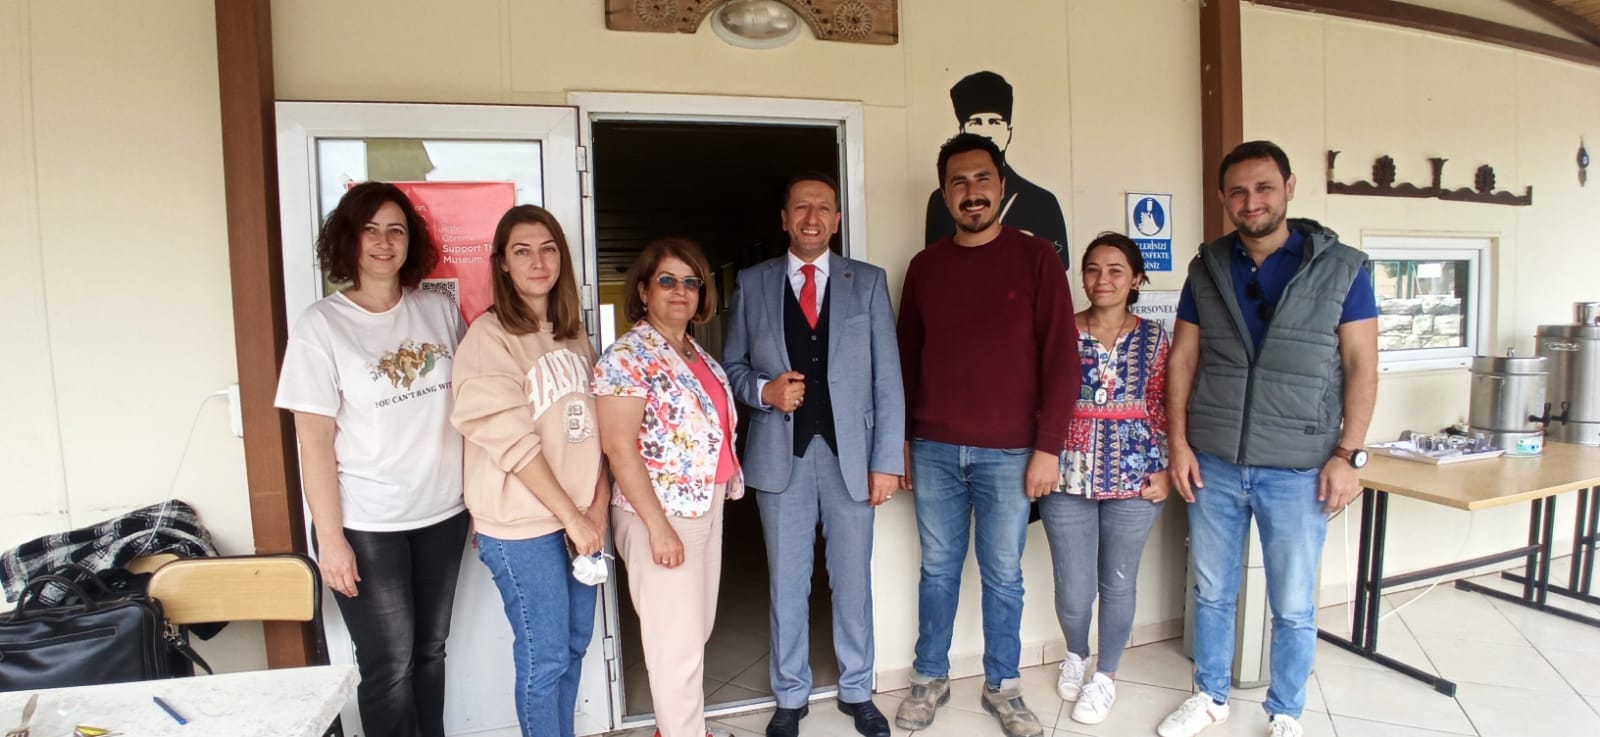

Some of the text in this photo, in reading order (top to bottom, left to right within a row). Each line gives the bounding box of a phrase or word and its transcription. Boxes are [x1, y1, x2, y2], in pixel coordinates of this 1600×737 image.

[442, 244, 481, 254] Support
[1136, 240, 1166, 249] LERİNİZİ
[391, 391, 415, 404] CAN'T
